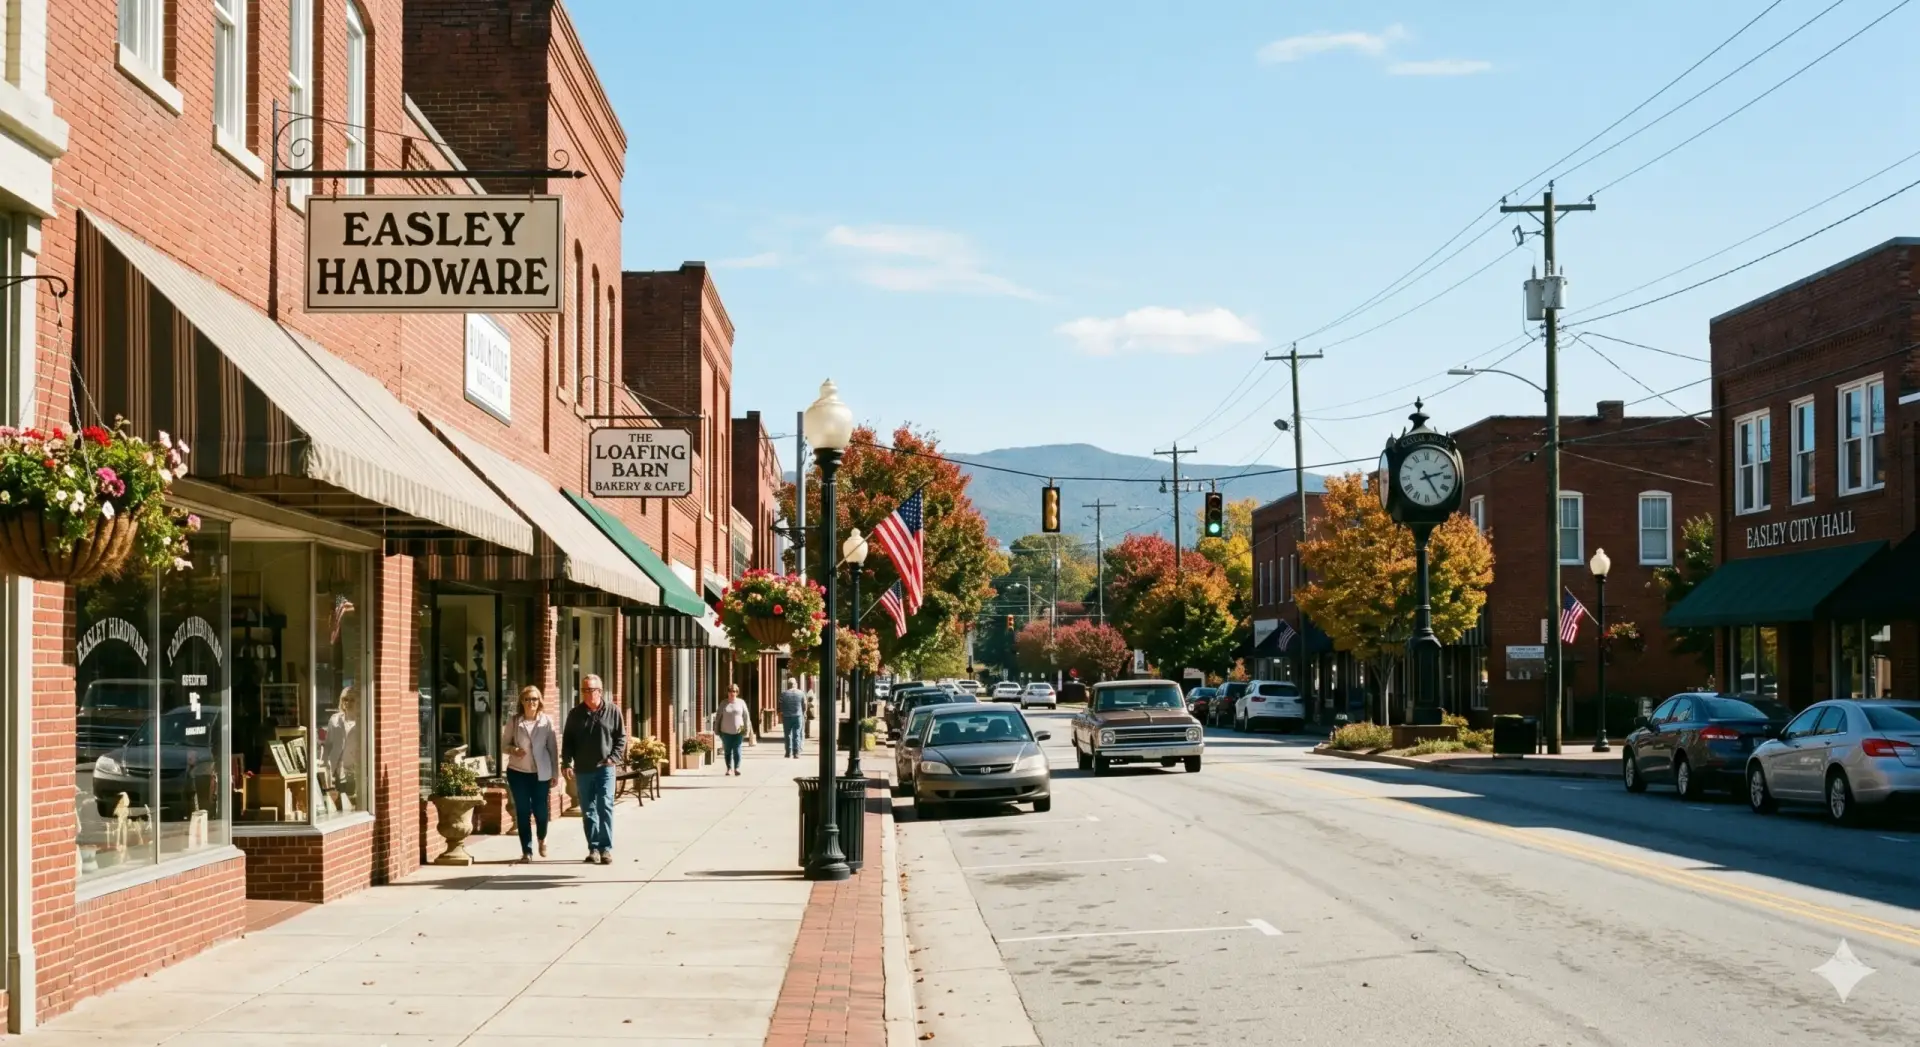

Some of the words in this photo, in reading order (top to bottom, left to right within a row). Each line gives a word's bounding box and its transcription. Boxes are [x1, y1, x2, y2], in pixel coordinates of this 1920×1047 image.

[342, 211, 525, 247] EASLEY
[316, 257, 549, 296] HARDWARE
[628, 433, 653, 442] THE
[595, 444, 686, 459] LOAFING
[611, 462, 669, 477] BARN
[595, 481, 640, 491] BAKERY
[643, 482, 652, 491] &
[655, 482, 685, 491] CAFE
[1746, 521, 1787, 549] EASLEY
[1789, 516, 1818, 543] CITY
[1821, 510, 1856, 538] HALL
[76, 618, 107, 666] EASLEY
